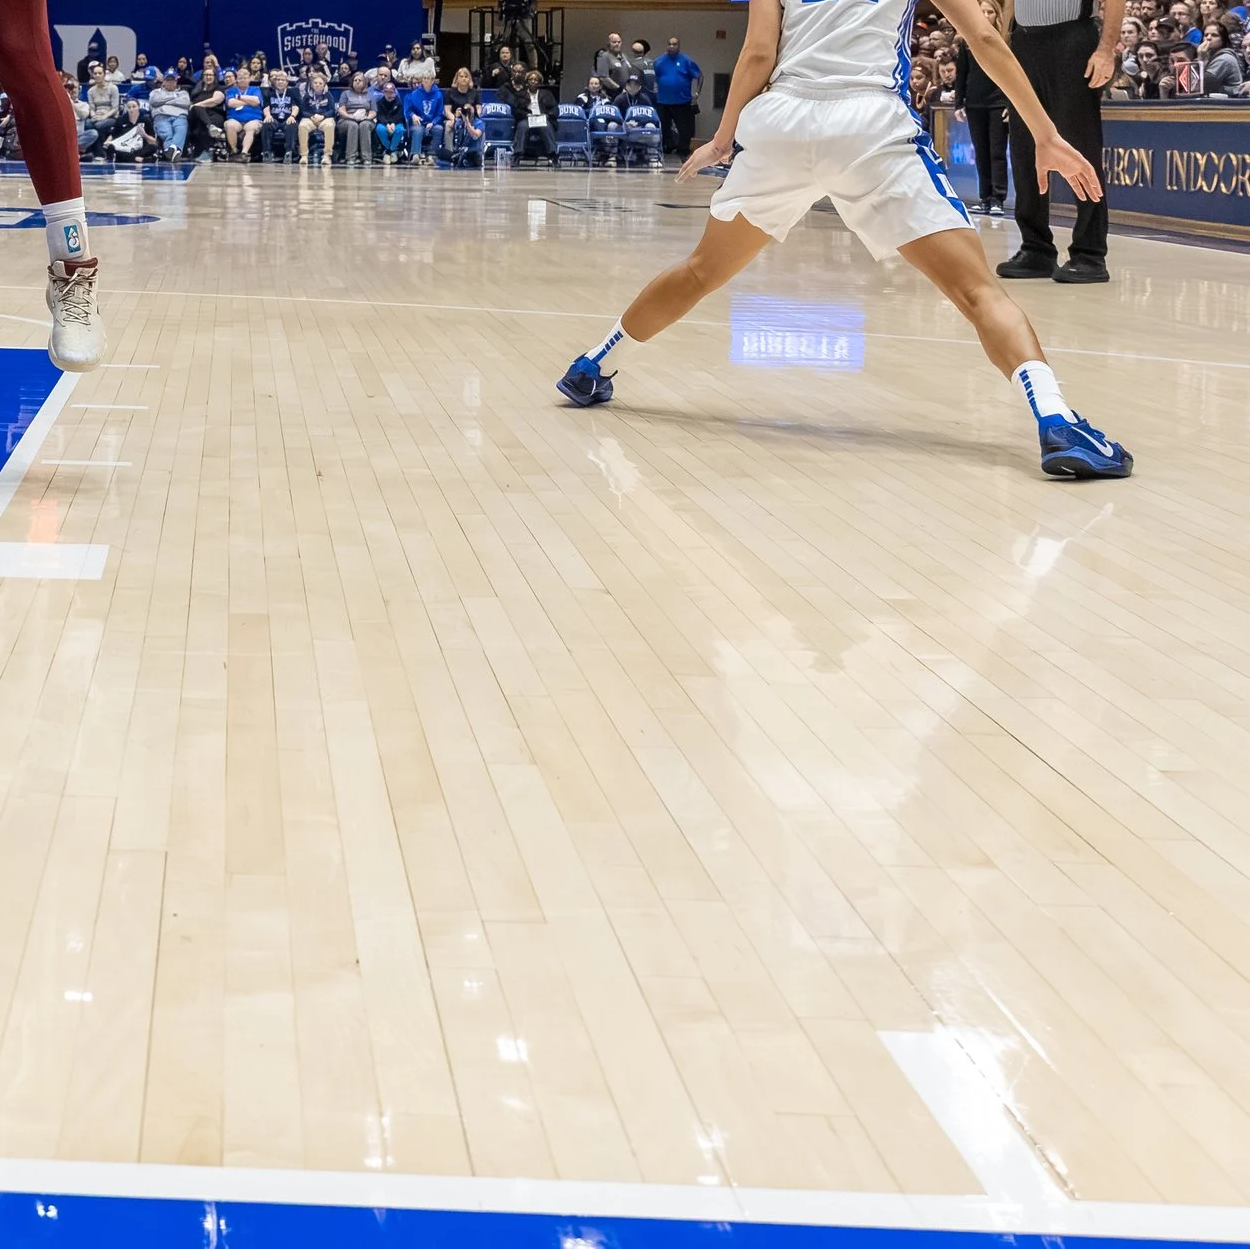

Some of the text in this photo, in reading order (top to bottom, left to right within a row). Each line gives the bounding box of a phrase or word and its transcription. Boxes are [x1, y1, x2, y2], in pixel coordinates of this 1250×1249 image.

[284, 34, 347, 52] SISTERHOOD
[486, 104, 507, 115] DUKE
[595, 105, 616, 116] DUKE
[632, 105, 653, 117] DUKE
[1166, 149, 1250, 197] INDOOR
